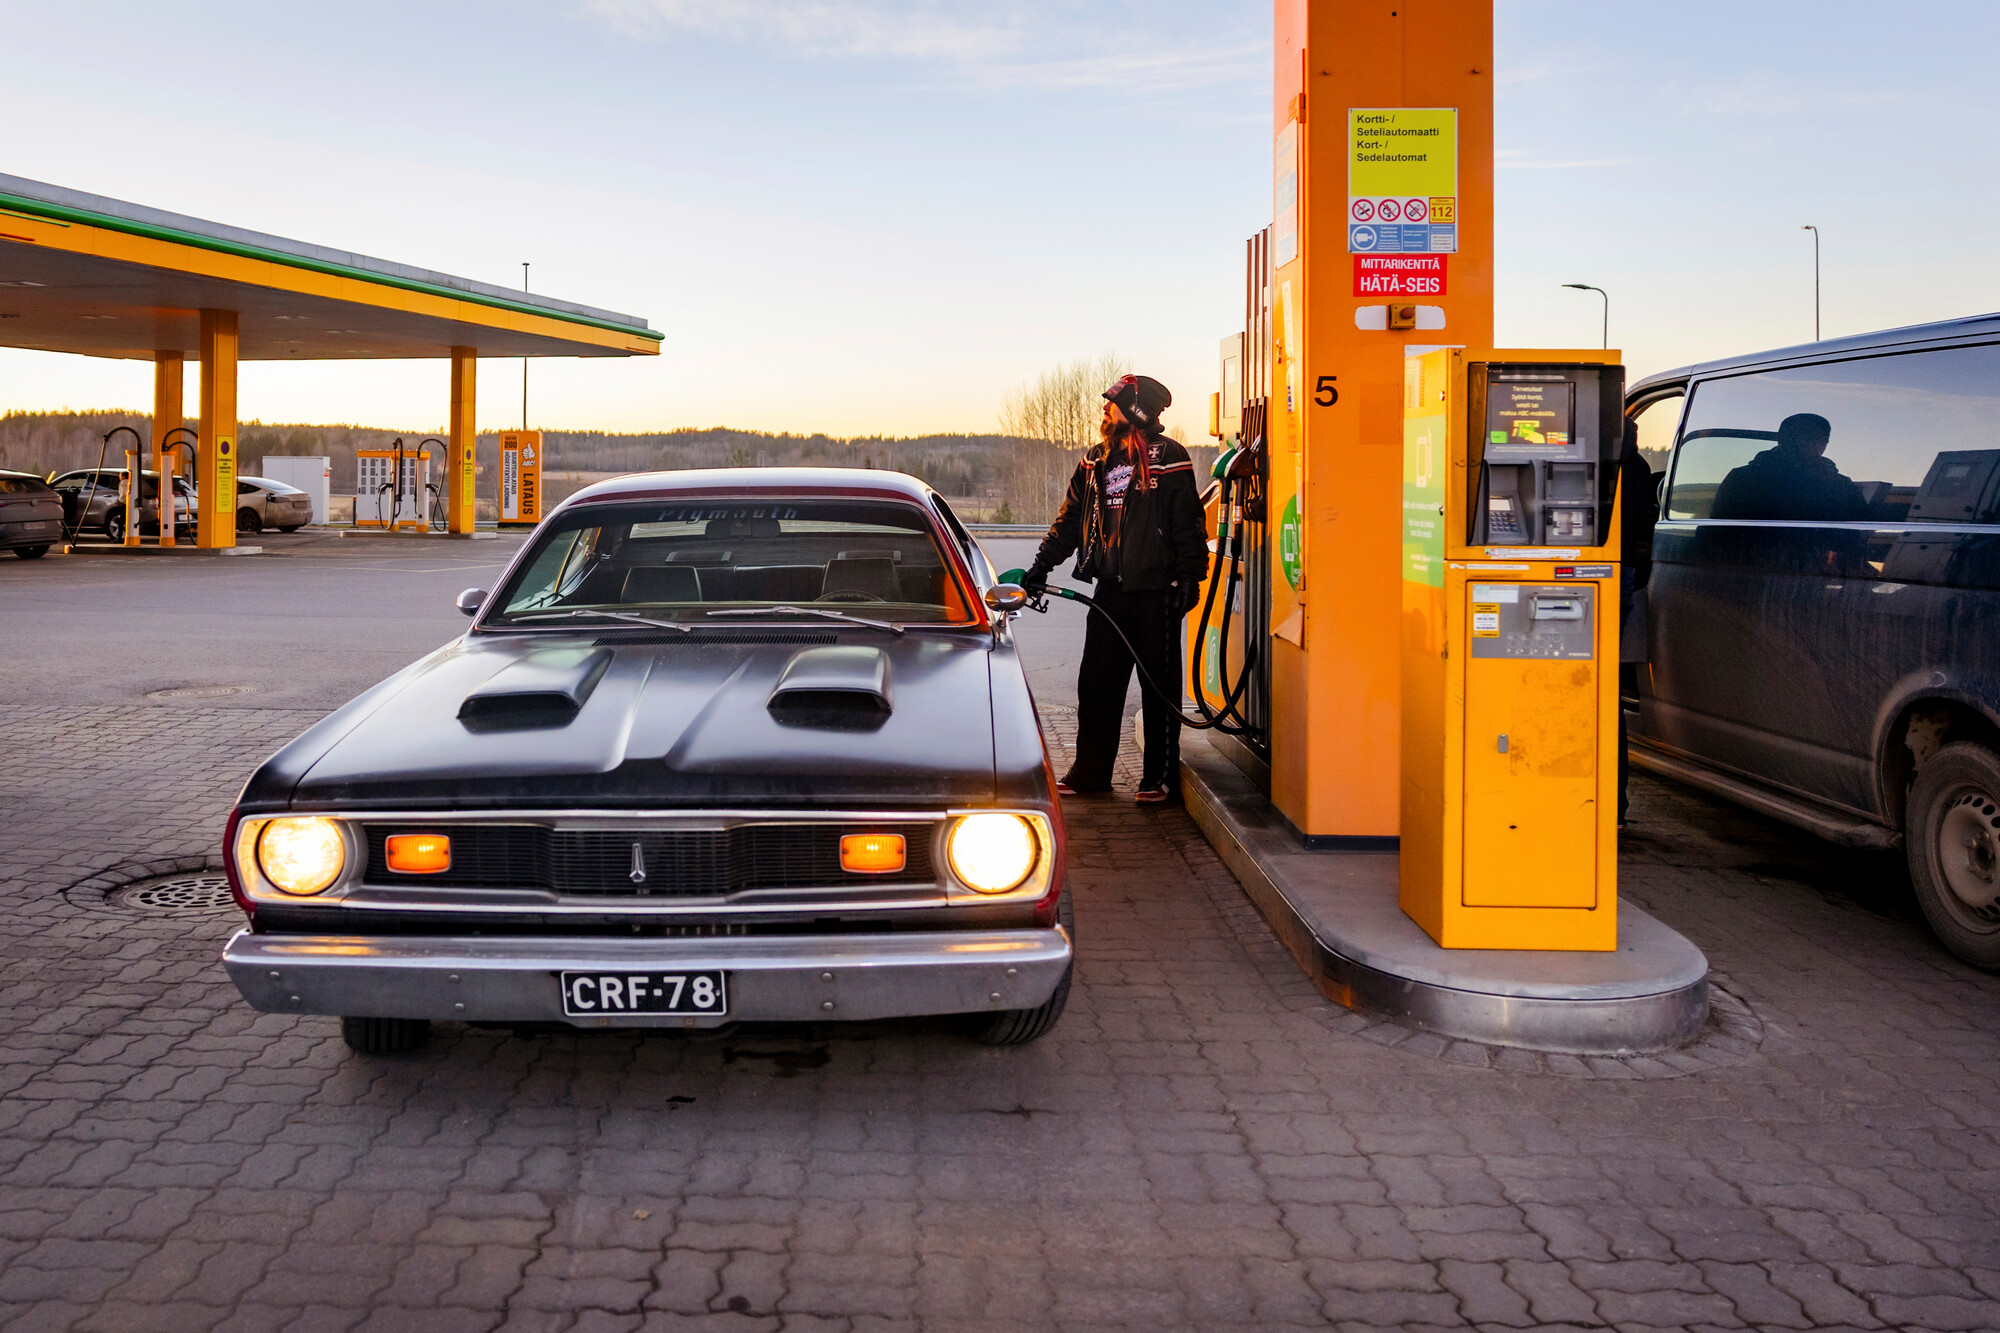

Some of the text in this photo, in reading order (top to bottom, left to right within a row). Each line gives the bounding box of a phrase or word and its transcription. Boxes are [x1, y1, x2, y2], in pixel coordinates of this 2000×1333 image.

[1357, 115, 1389, 124] Kortti-
[1357, 127, 1439, 137] Seteliautomaatti
[1357, 140, 1383, 149] Kort-
[1357, 153, 1427, 162] Sedelautomat
[1431, 206, 1453, 218] 112
[1361, 257, 1440, 270] MITTARIKENTTÄ
[1360, 273, 1440, 293] HÄTÄ-SEIS
[1314, 375, 1339, 407] 5
[504, 441, 518, 449] 200
[522, 473, 534, 515] LATAUS
[658, 506, 798, 525] Plymouth
[572, 975, 717, 1010] CRF-78
